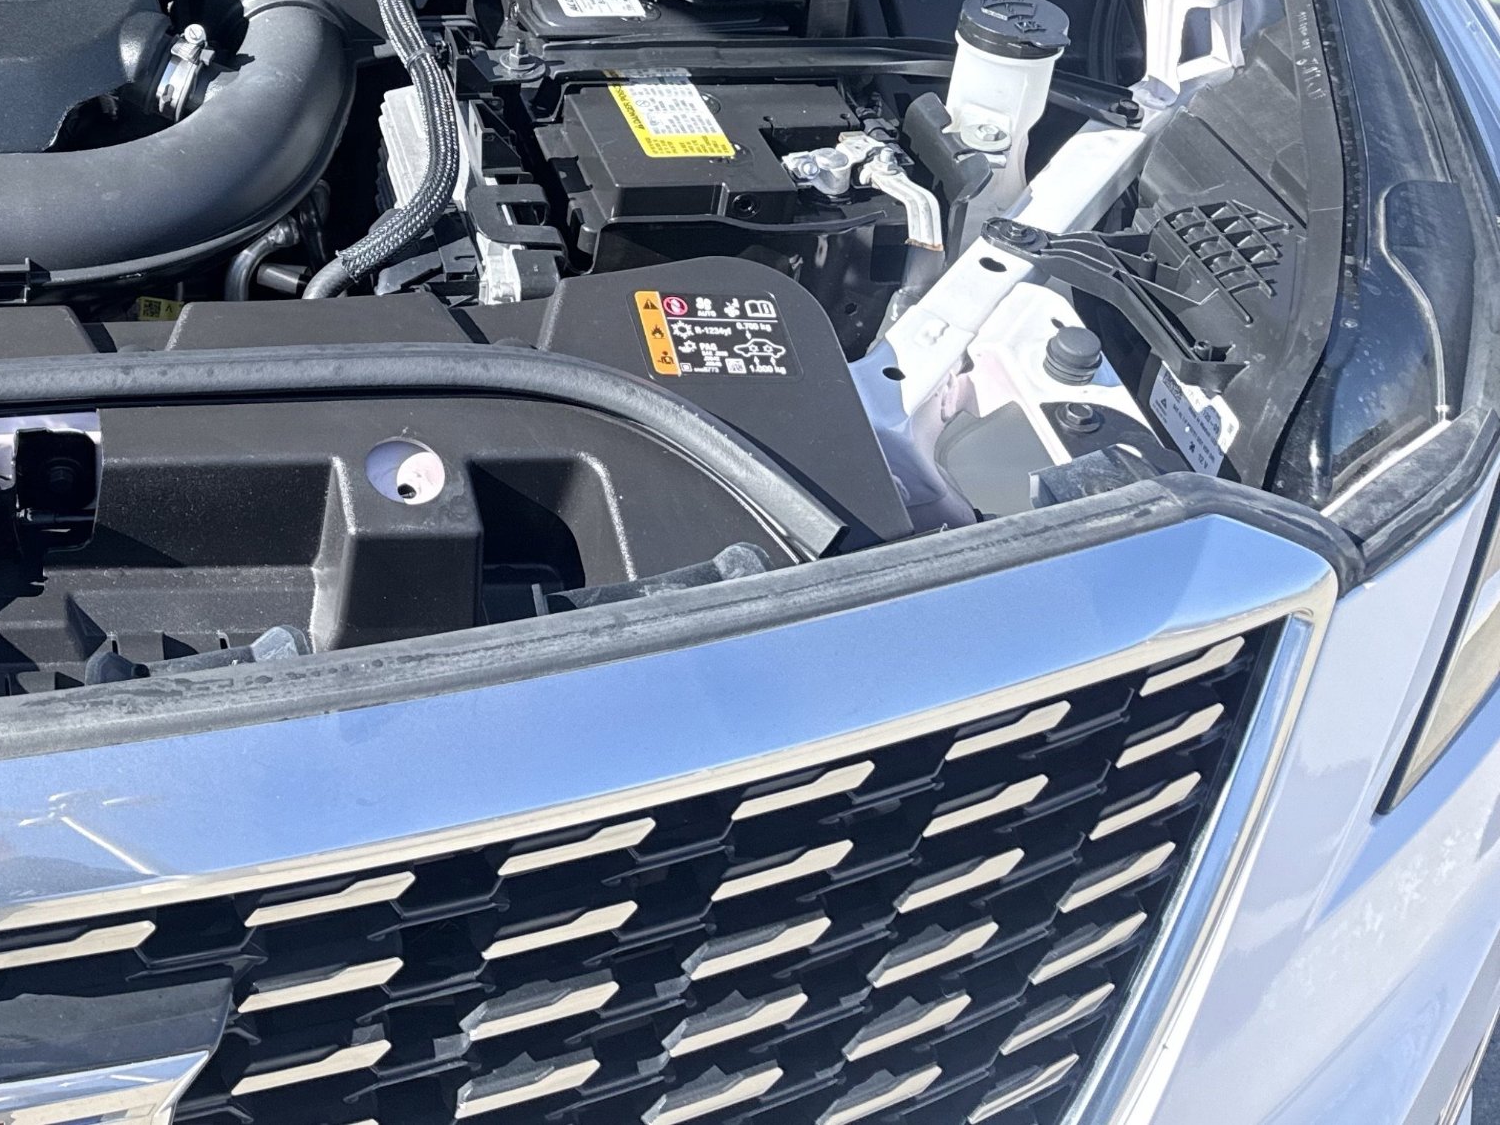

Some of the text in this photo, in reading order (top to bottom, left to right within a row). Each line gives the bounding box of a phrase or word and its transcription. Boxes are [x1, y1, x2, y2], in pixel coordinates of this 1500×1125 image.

[623, 101, 641, 125] DANGER
[694, 326, 732, 336] R-1234yf
[760, 323, 772, 332] kg
[699, 343, 717, 351] PAG
[774, 365, 787, 375] kg
